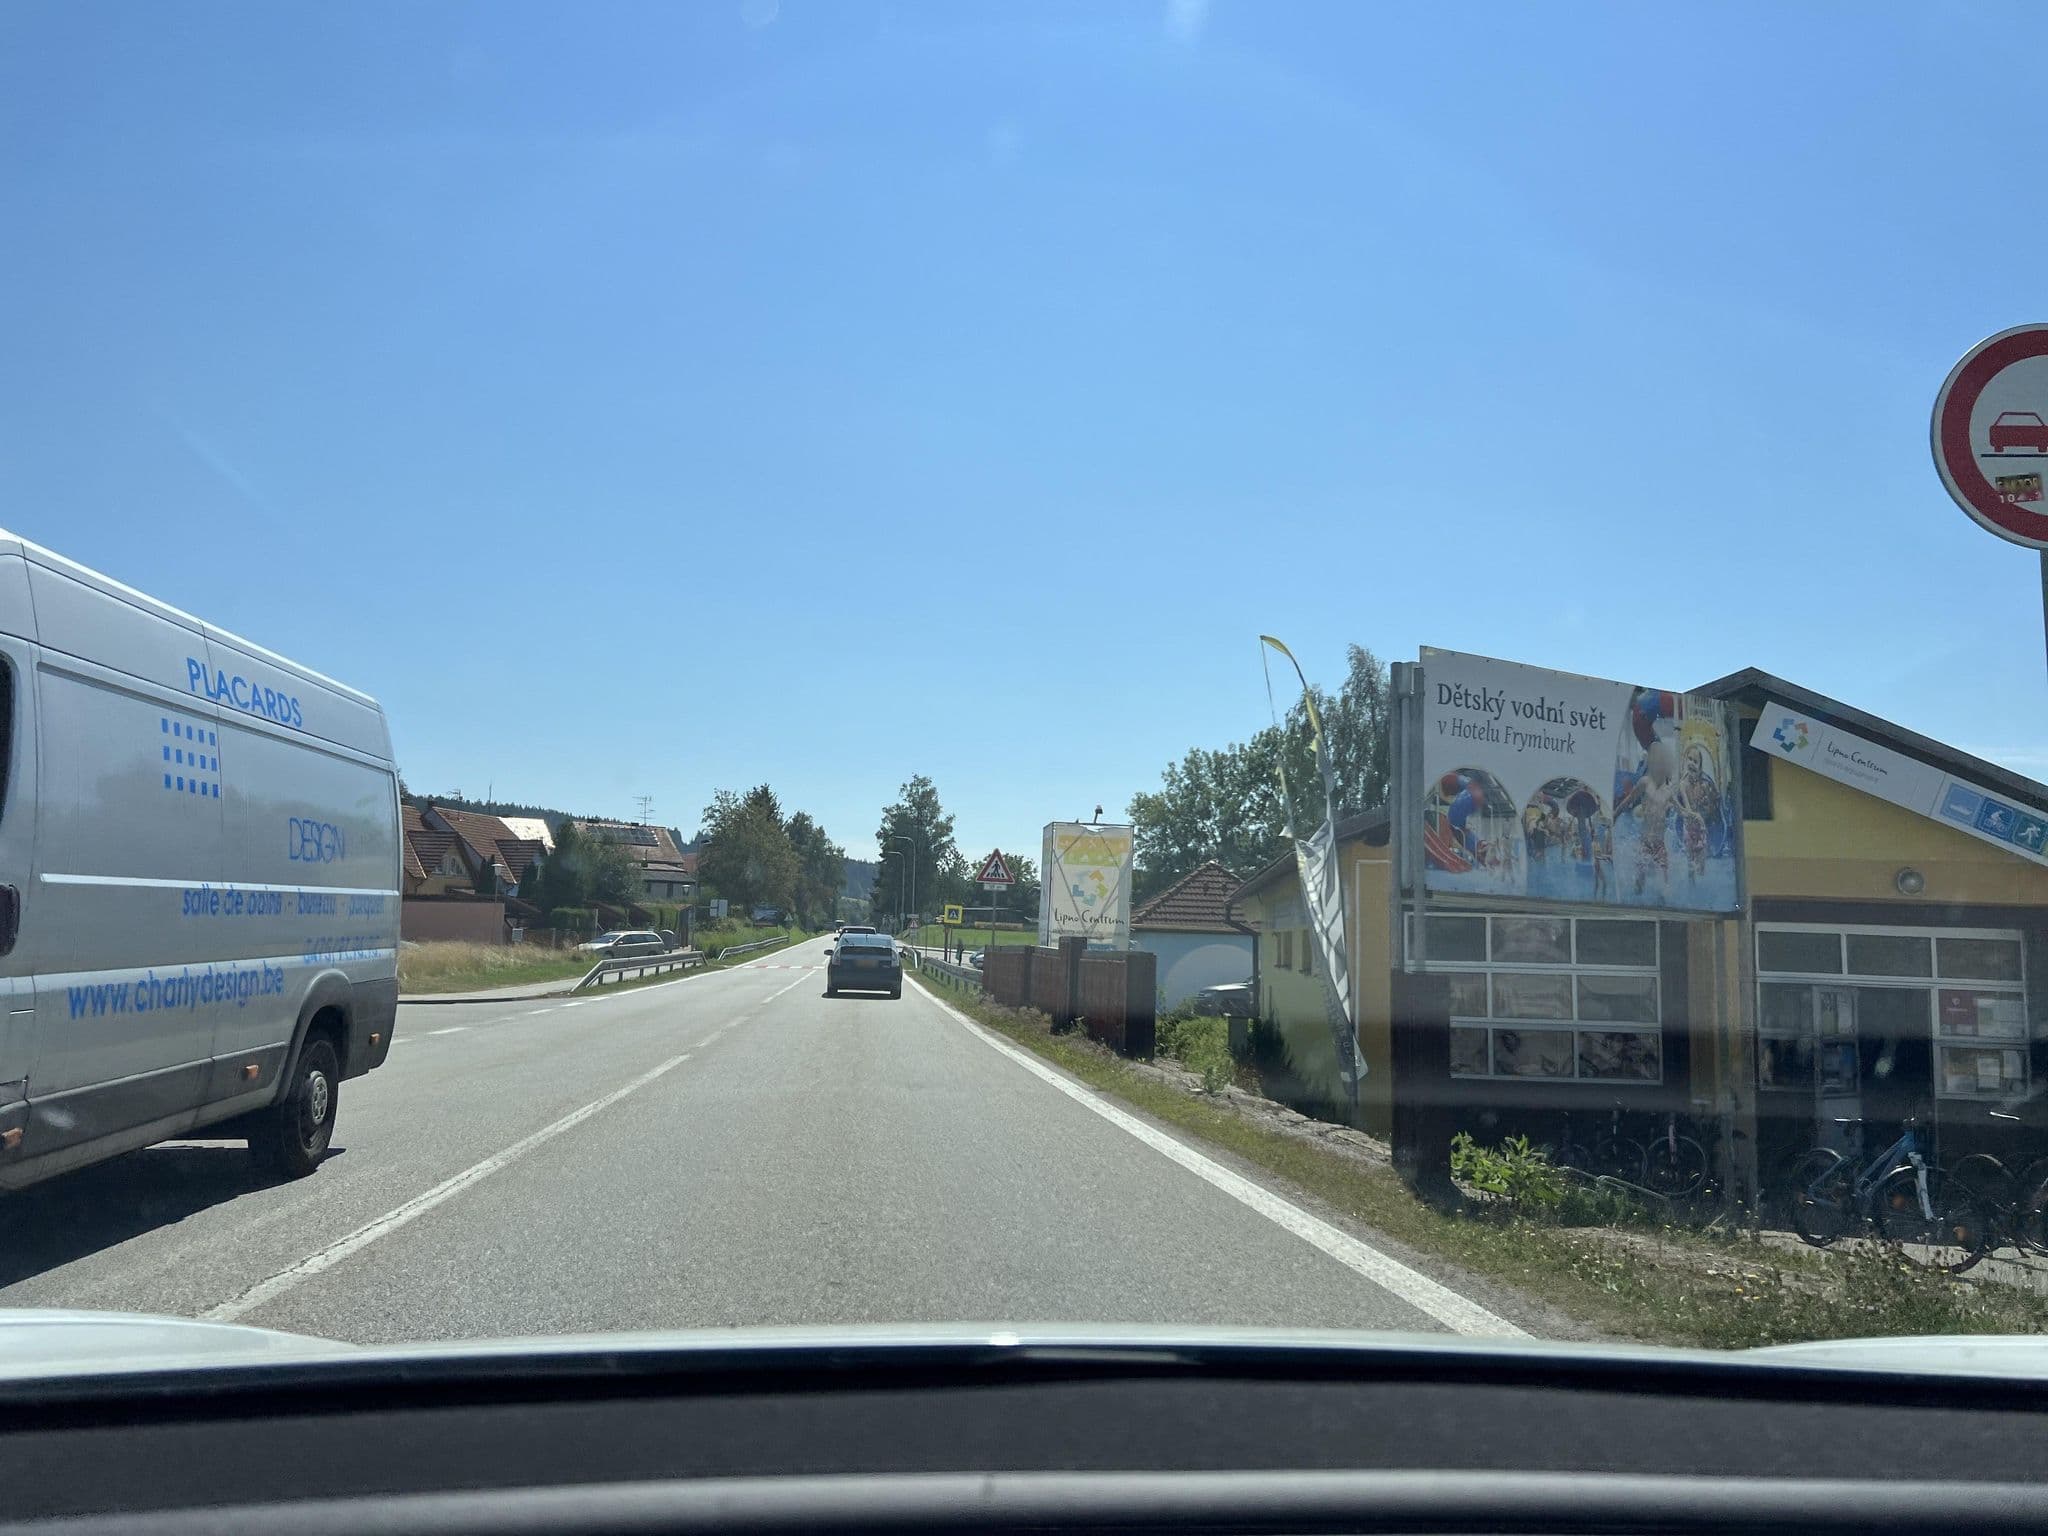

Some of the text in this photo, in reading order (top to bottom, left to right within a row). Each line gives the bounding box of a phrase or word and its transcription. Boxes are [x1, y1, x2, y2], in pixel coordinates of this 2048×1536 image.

[186, 656, 303, 728] PLACARDS
[1437, 682, 1607, 731] Dětský vodní svět
[1437, 717, 1577, 754] v Hotelu Frymburk
[1851, 751, 1888, 776] Centrum
[289, 817, 345, 864] DESIGN
[183, 884, 220, 916] salle
[224, 885, 244, 916] de
[1054, 908, 1125, 925] Lipno Centrum
